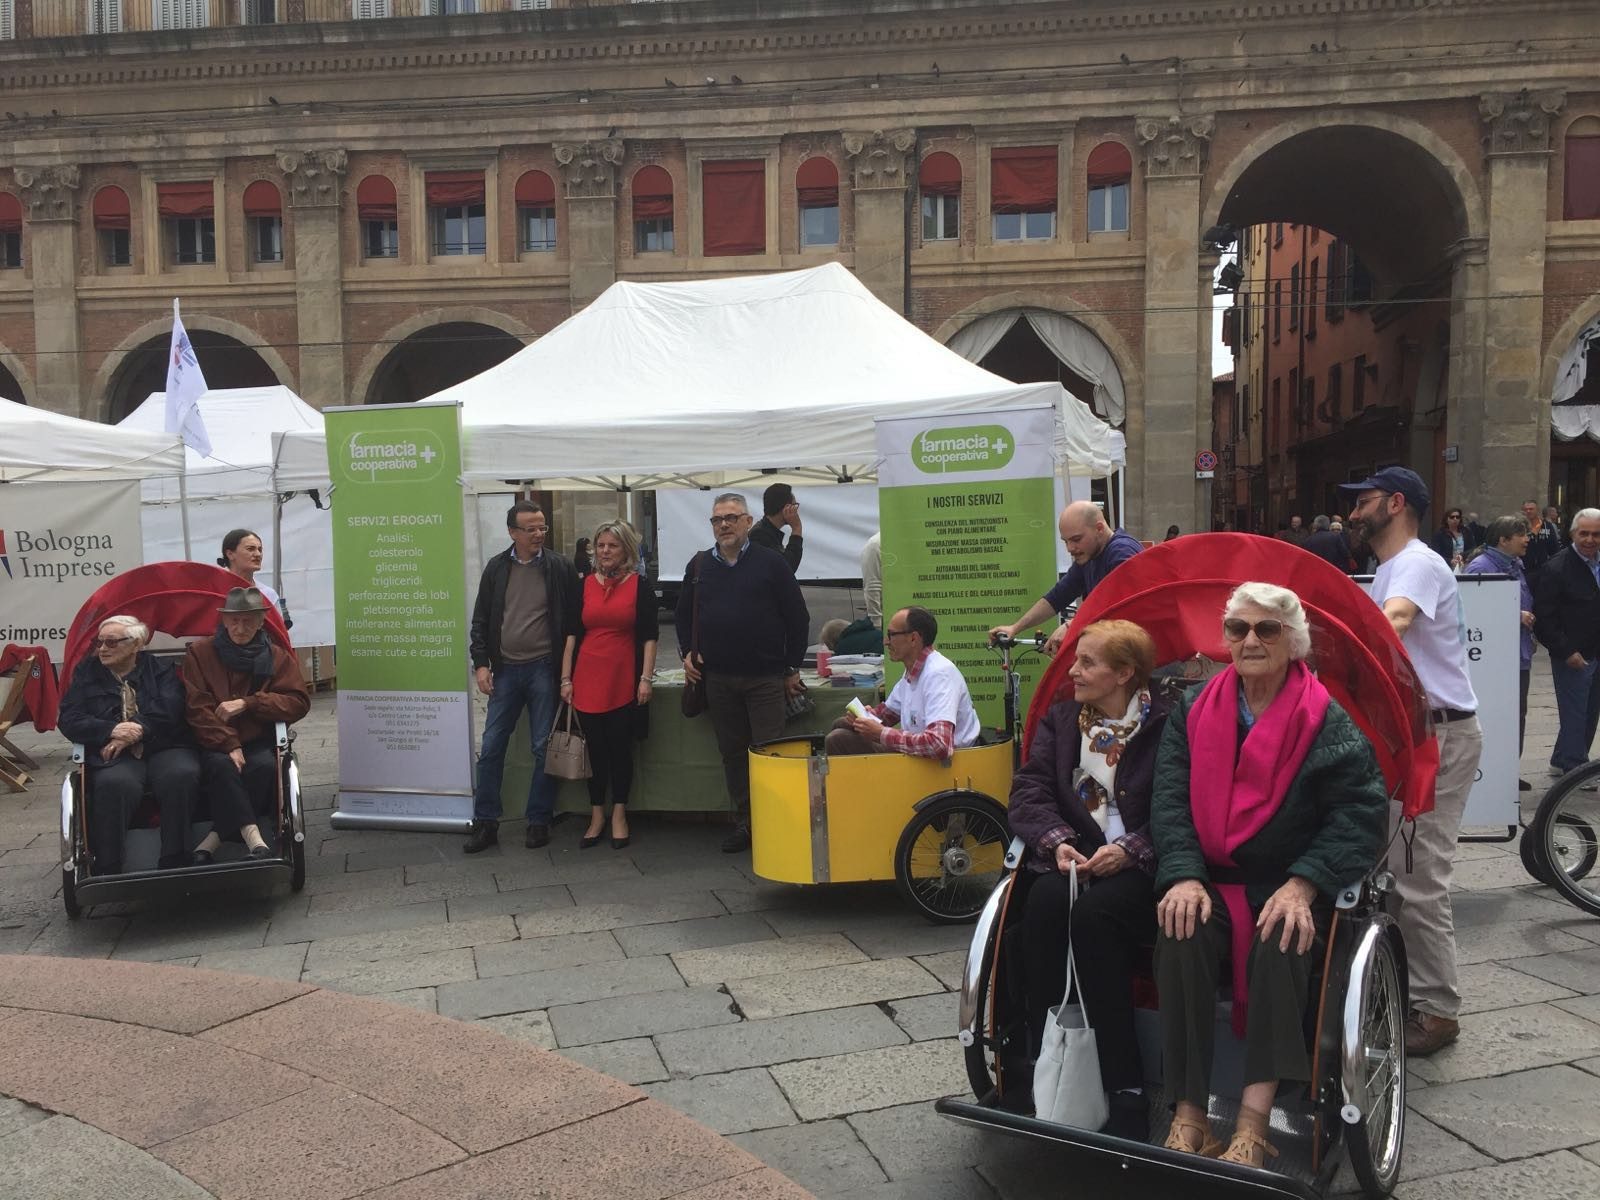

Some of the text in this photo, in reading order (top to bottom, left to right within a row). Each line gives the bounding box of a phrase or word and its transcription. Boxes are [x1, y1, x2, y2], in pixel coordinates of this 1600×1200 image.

[349, 432, 417, 458] farmacia
[920, 429, 988, 452] farmacia
[921, 450, 988, 472] cooperativa
[350, 458, 417, 481] cooperativa
[927, 493, 1004, 508] I NOSTRI SERVIZI
[348, 514, 442, 526] SERVIZI EROGATI
[969, 518, 1008, 526] NUTRIZIONISTA
[14, 529, 113, 557] Bologna
[376, 533, 414, 543] Analisi:
[368, 548, 423, 558] colesterolo
[19, 557, 115, 582] Imprese
[376, 562, 417, 573] glicemia
[372, 576, 422, 588] trigliceridi
[349, 590, 449, 602] perforazione dei lobi
[363, 604, 433, 616] pletismografia
[346, 619, 456, 629] intolleranze alimentari
[350, 634, 452, 645] esame massa magra
[352, 649, 382, 657] esame
[385, 648, 407, 657] cute
[420, 647, 451, 659] capelli
